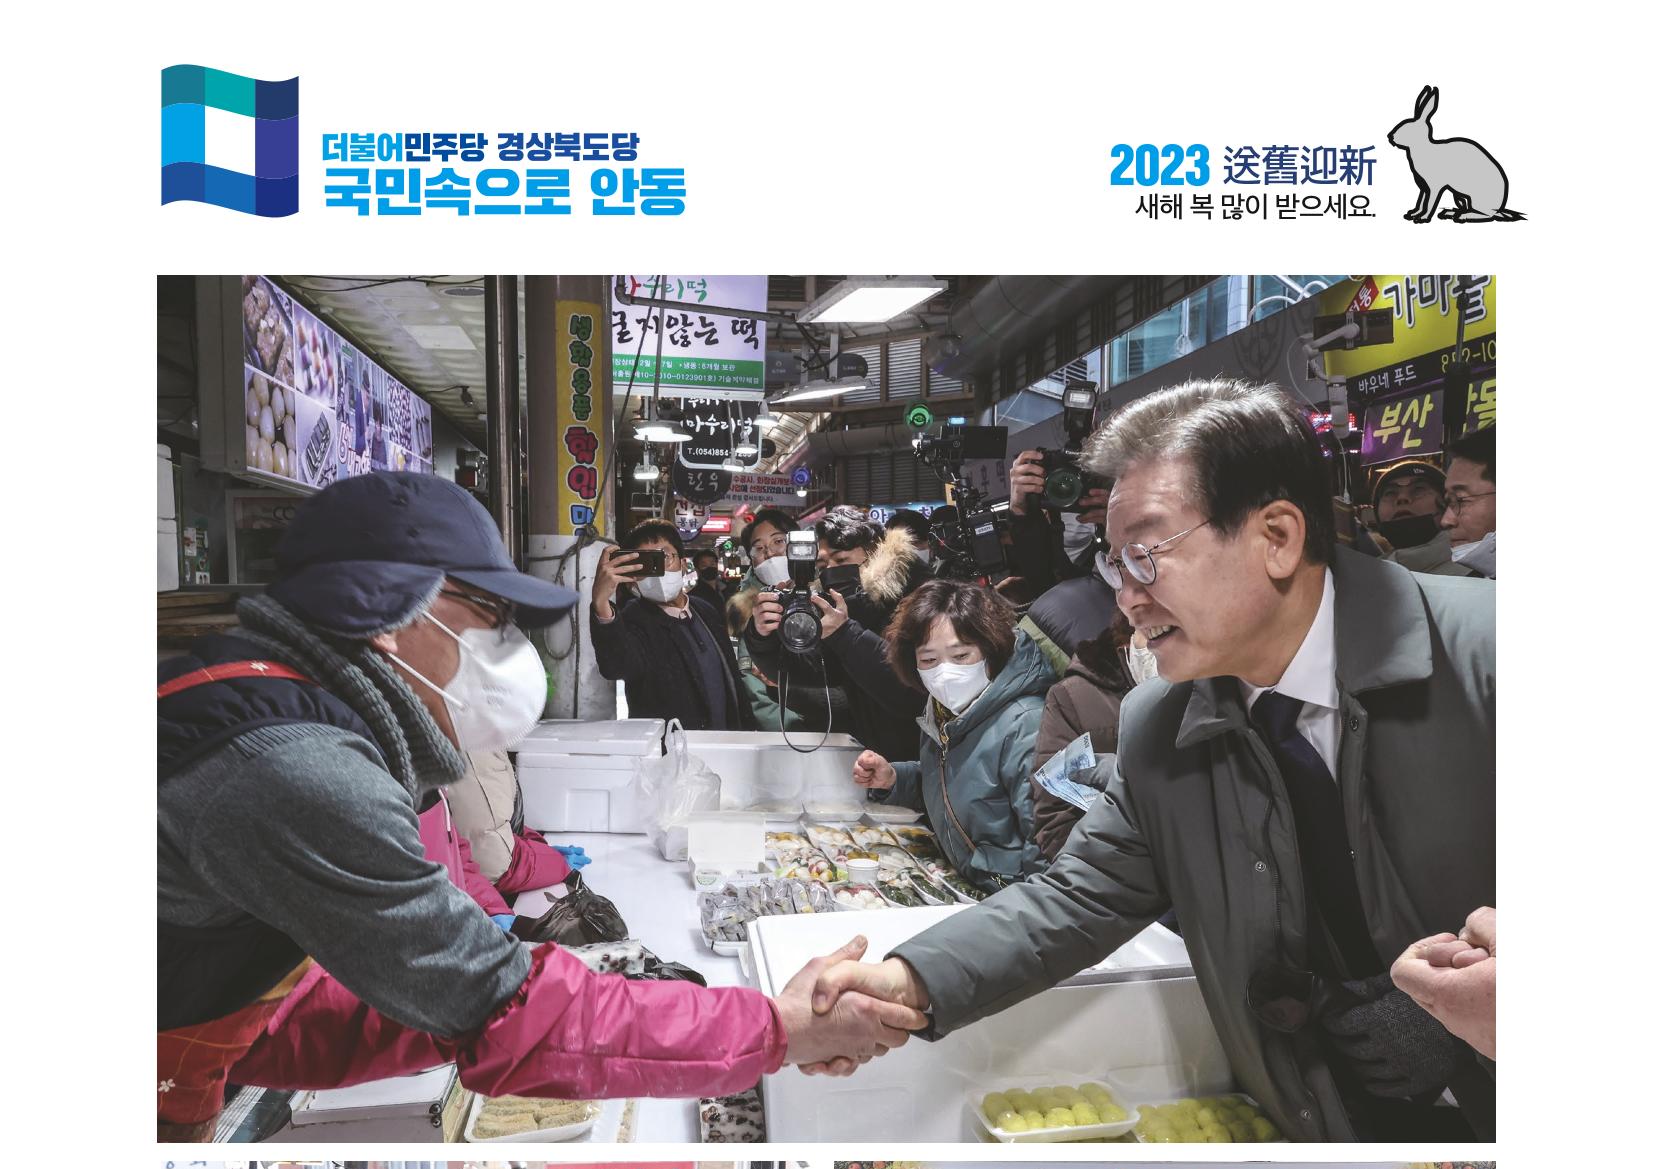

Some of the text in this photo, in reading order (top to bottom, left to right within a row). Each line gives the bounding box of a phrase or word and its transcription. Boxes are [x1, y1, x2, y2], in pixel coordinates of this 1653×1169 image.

[731, 319, 759, 349] 떡
[1358, 363, 1417, 395] 바우네 푸드
[1373, 394, 1433, 449] 부산
